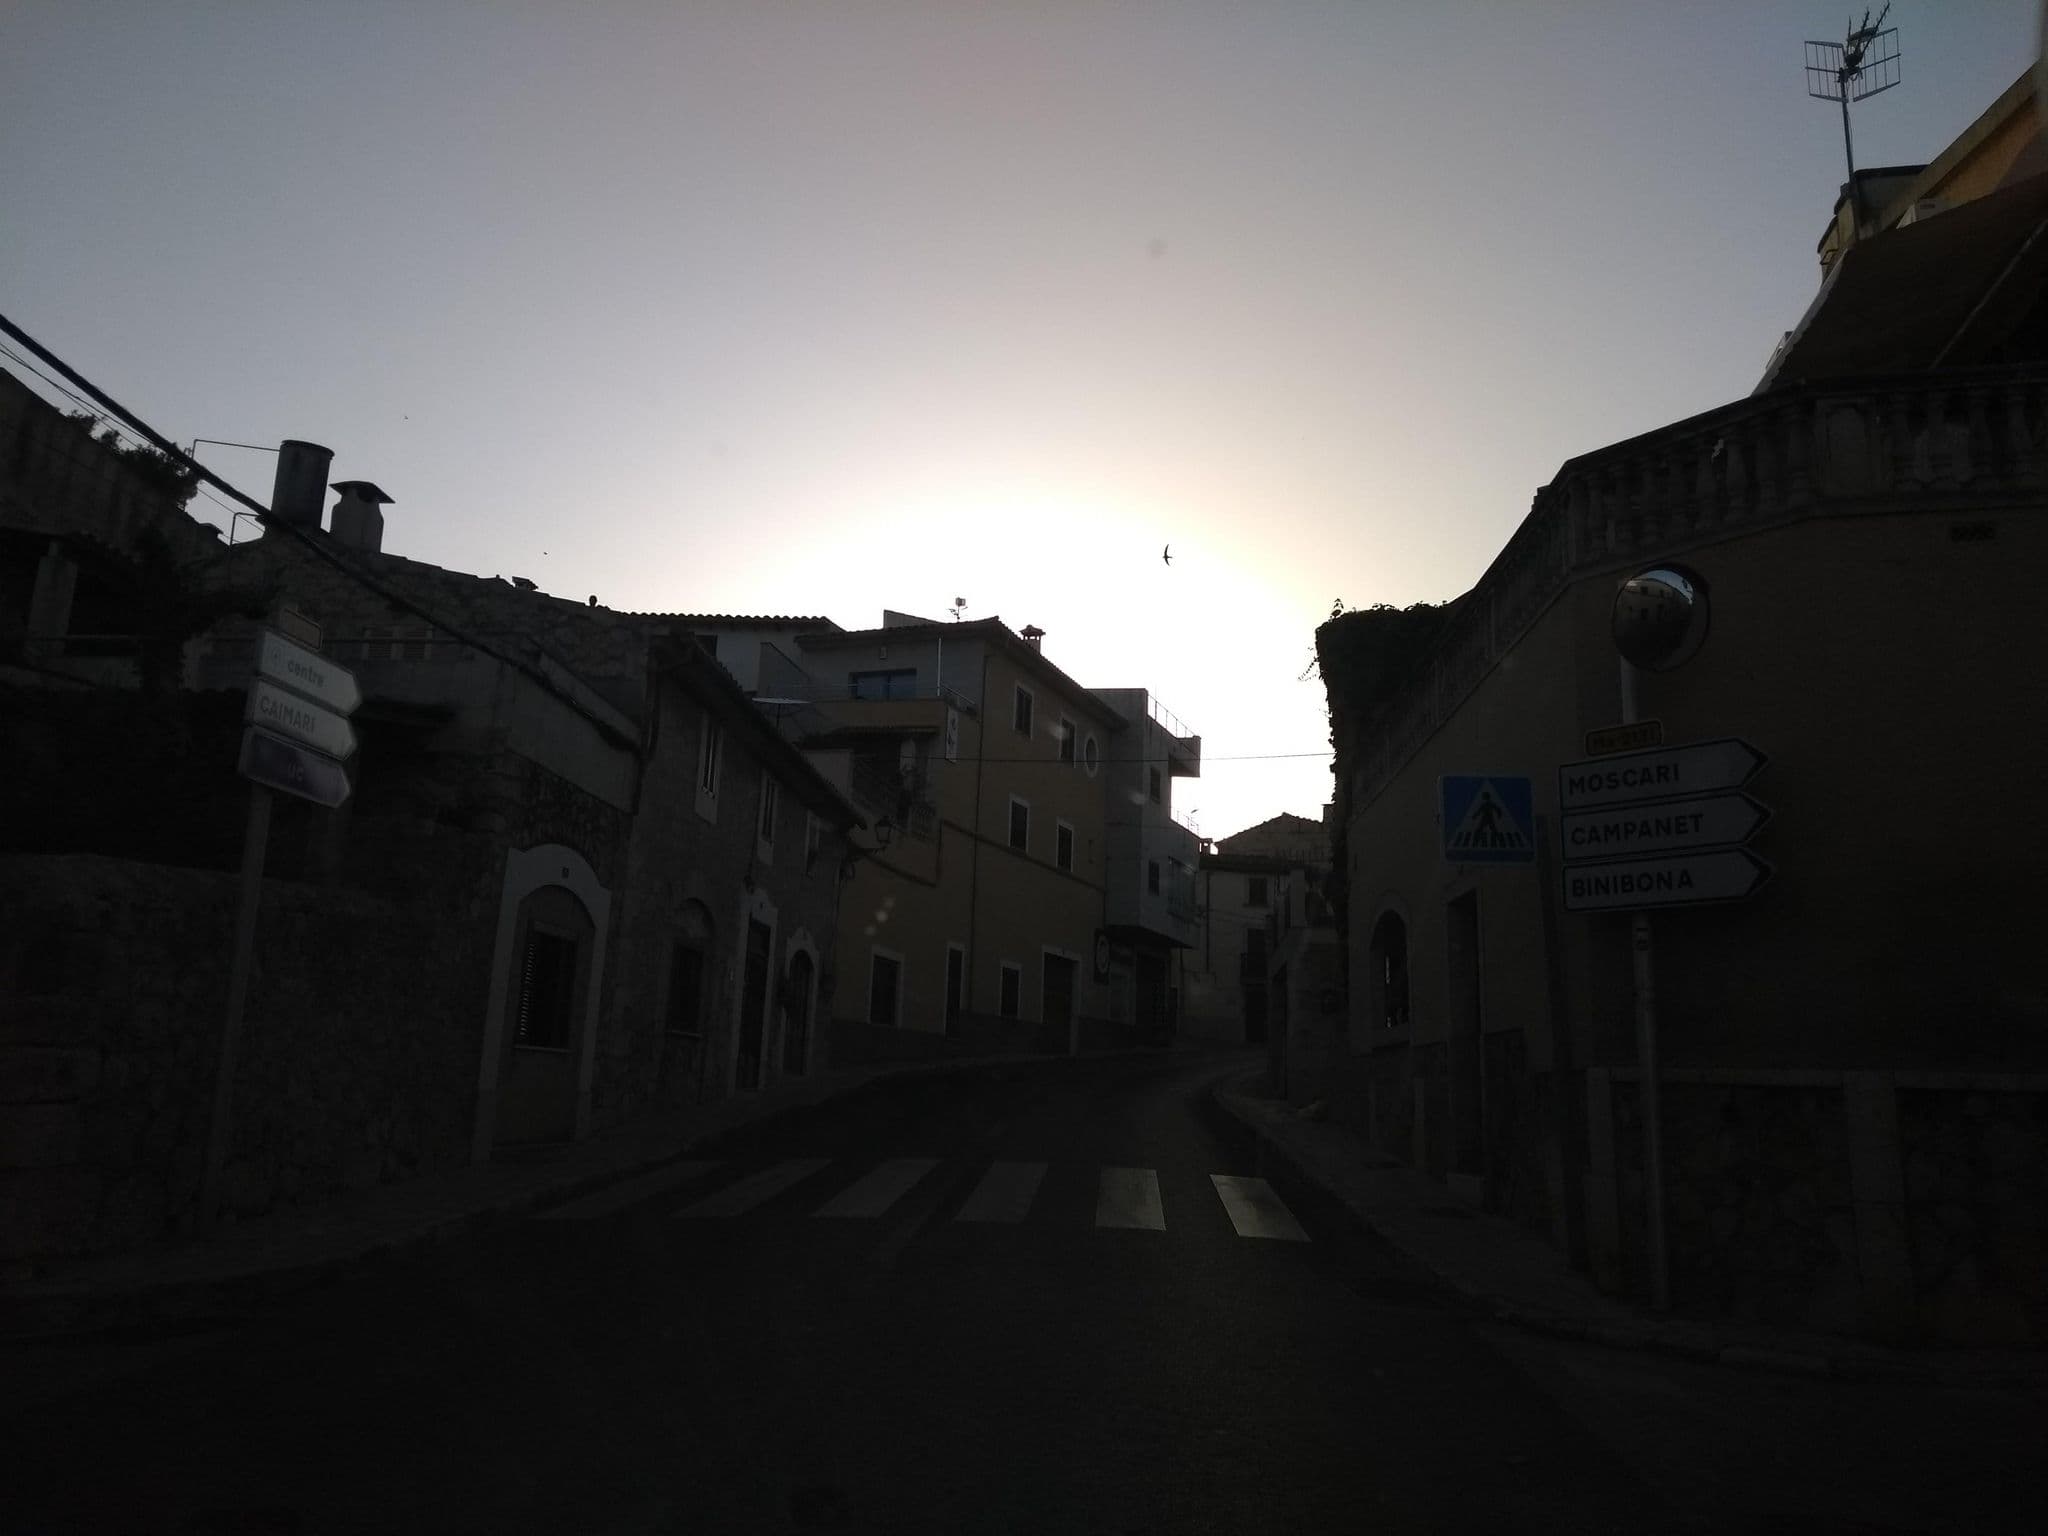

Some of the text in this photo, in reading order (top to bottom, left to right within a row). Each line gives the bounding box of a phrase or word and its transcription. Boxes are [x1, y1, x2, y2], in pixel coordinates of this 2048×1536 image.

[261, 696, 315, 732] CAIMARI
[1569, 764, 1679, 795] MOSCARI
[1571, 814, 1704, 845] CAMPANET
[1572, 869, 1693, 898] BINIBONA
